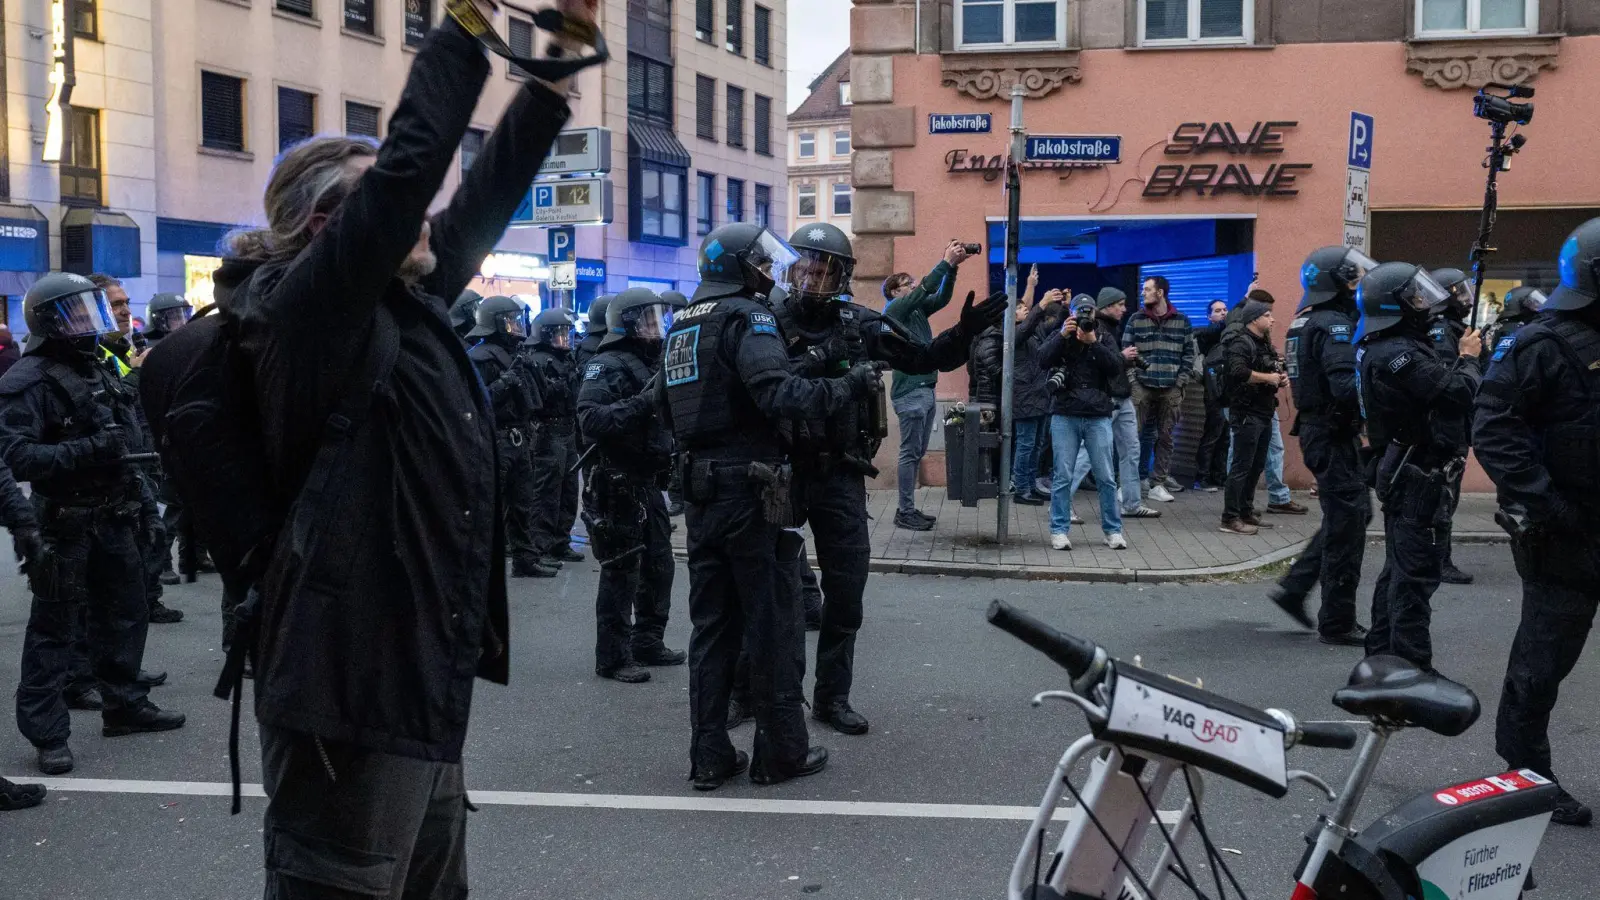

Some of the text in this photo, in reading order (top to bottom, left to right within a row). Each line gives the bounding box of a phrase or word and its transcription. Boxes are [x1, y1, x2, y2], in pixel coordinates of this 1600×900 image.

[932, 115, 988, 132] Jakobstraße
[1164, 121, 1298, 155] SAVE
[1352, 119, 1367, 159] P
[1033, 139, 1111, 157] Jakobstraße
[539, 159, 566, 169] aximum
[1142, 163, 1313, 197] BRAVE
[539, 188, 549, 205] P
[535, 207, 562, 216] City-Point
[554, 231, 569, 258] P
[596, 268, 603, 277] 20
[673, 302, 718, 323] POLIZEI
[754, 314, 773, 324] USK
[675, 333, 690, 349] BY
[1392, 355, 1408, 369] USK
[1162, 705, 1238, 743] VAG RAD
[1464, 845, 1499, 868] Fürther
[1468, 863, 1521, 893] FlitzeFritze
